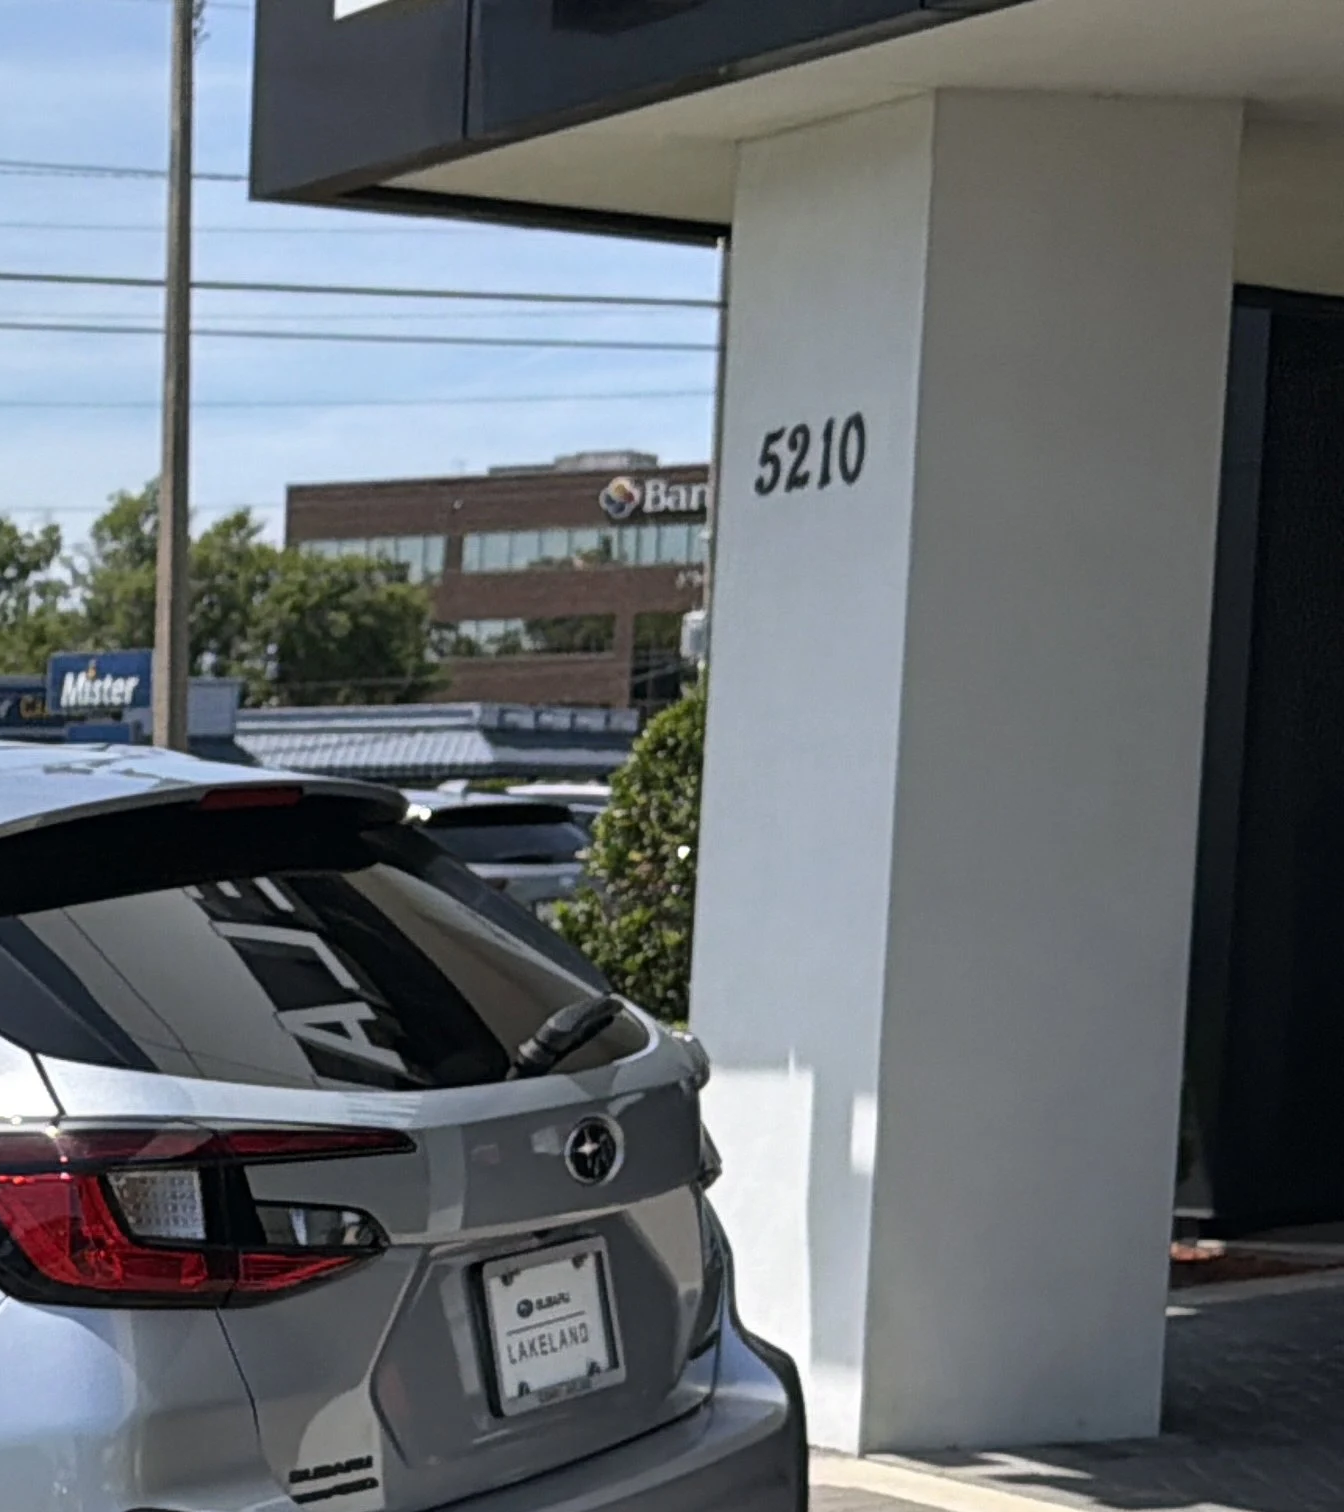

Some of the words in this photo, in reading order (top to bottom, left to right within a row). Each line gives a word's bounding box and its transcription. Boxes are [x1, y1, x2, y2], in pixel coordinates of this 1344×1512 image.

[755, 411, 866, 496] 5210
[60, 671, 139, 707] Mister
[506, 1321, 590, 1365] LAKELAND
